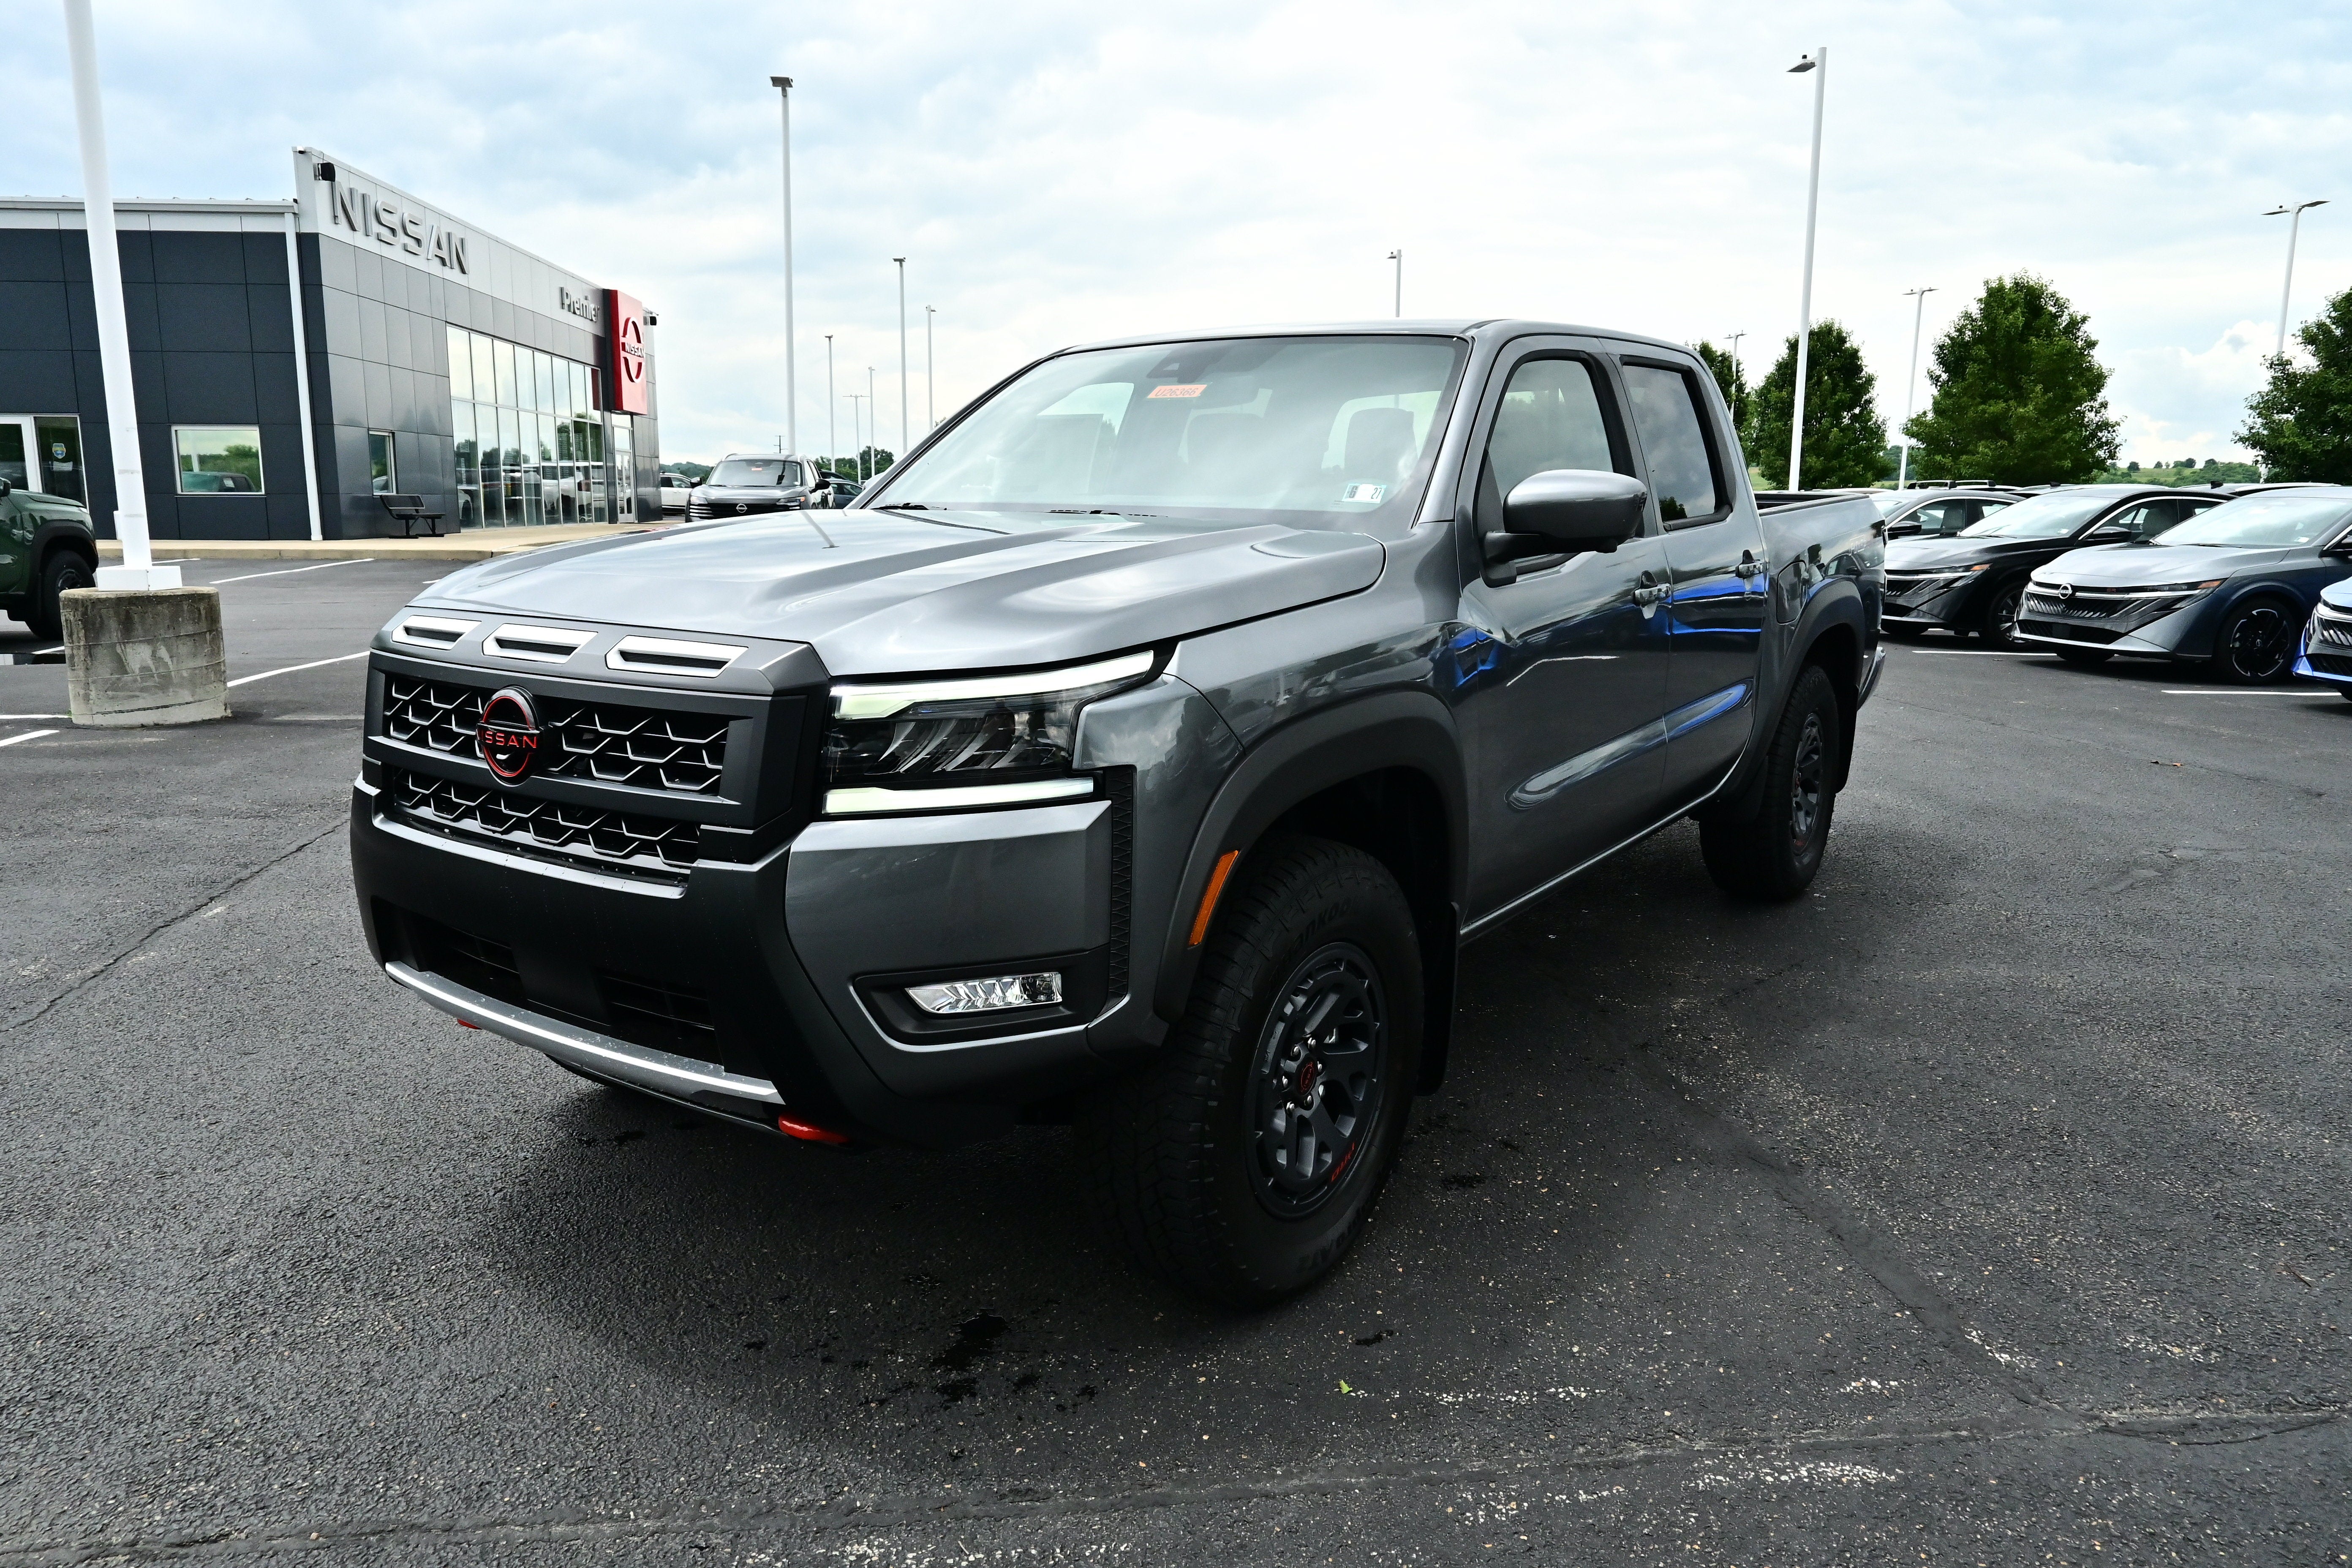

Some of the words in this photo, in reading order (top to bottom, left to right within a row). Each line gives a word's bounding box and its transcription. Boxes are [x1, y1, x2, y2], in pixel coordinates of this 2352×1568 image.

[331, 180, 470, 275] NISSAN
[559, 287, 600, 322] Premier
[625, 342, 645, 358] NISSAN
[1154, 388, 1199, 397] U26366
[1349, 486, 1358, 498] 6
[1371, 487, 1383, 499] 27
[482, 730, 537, 748] SSAN
